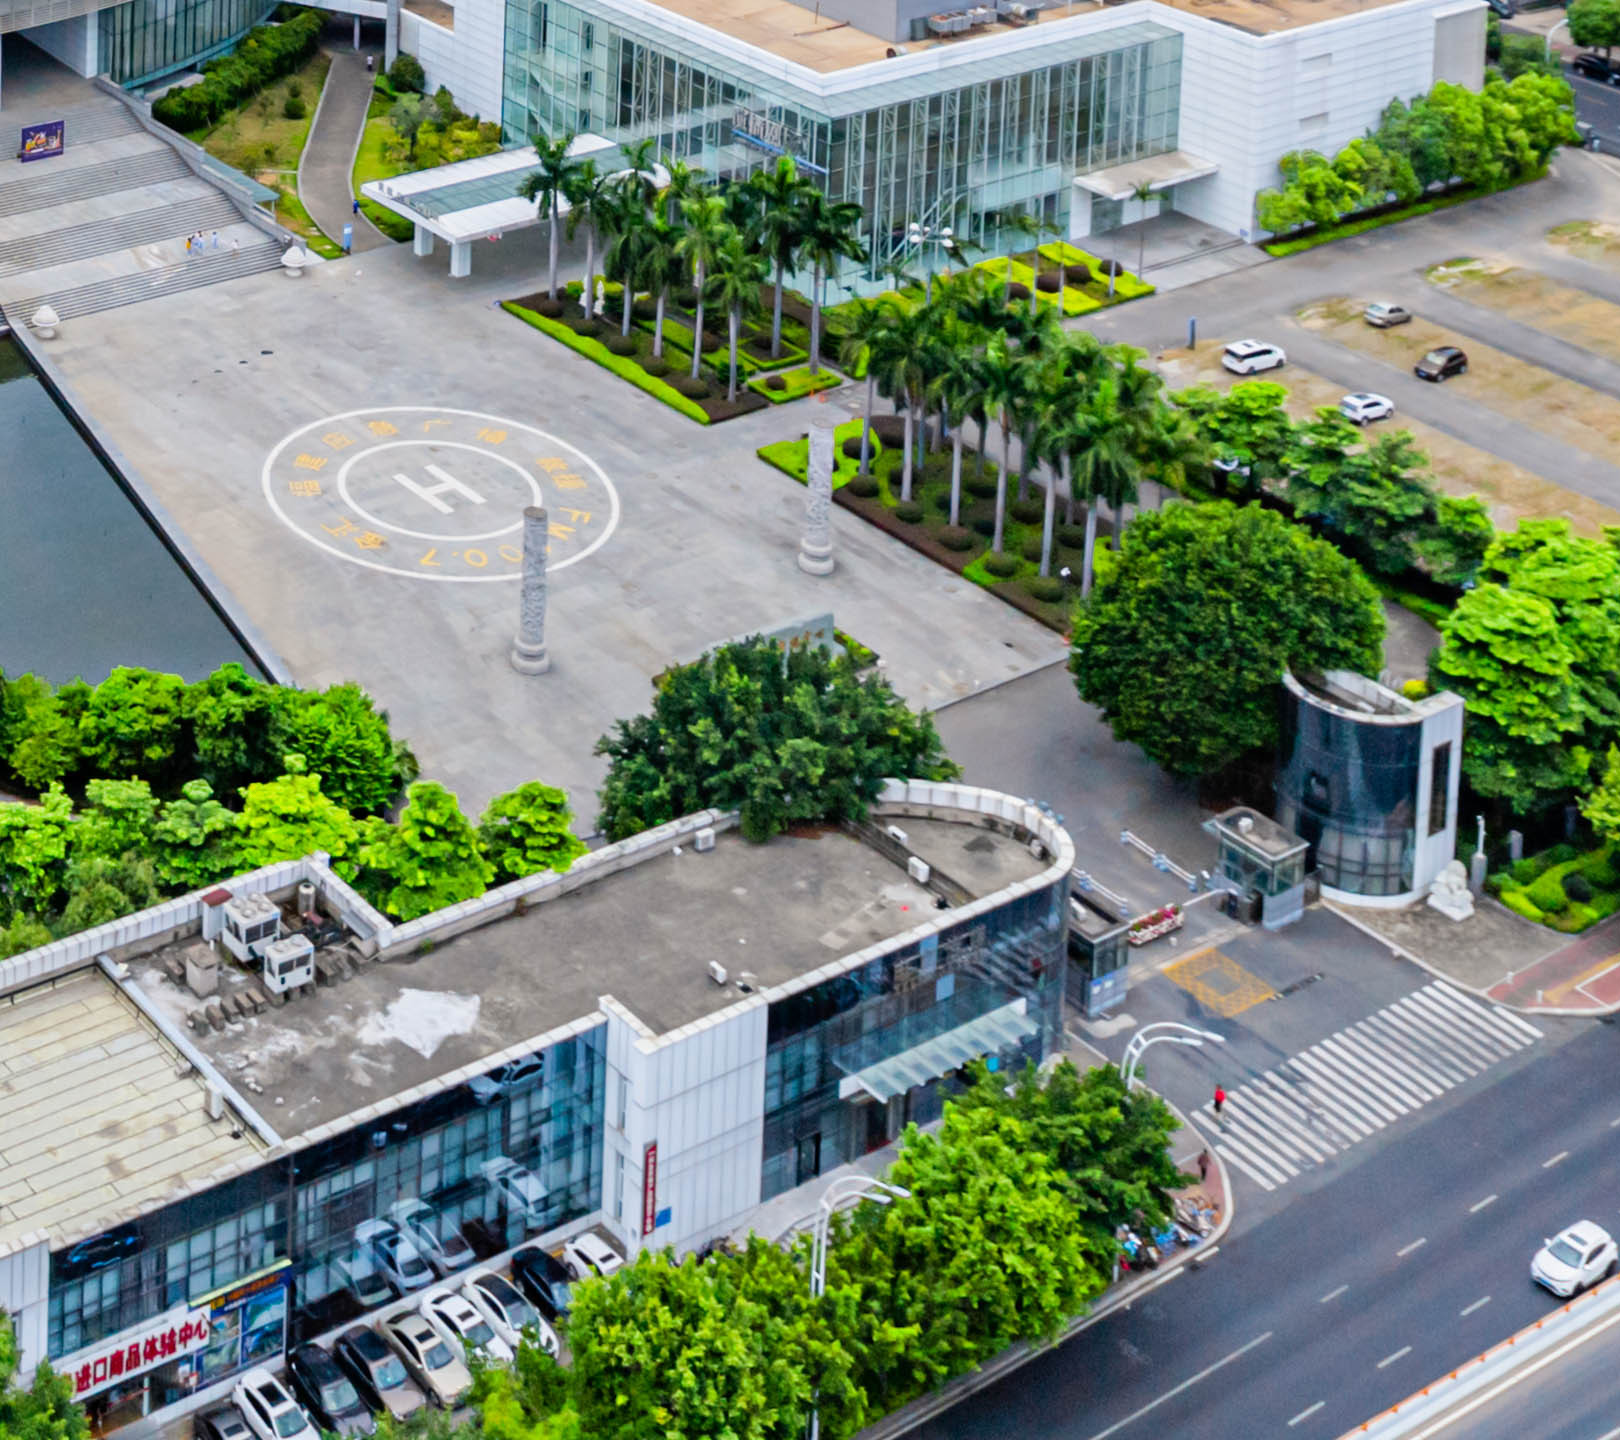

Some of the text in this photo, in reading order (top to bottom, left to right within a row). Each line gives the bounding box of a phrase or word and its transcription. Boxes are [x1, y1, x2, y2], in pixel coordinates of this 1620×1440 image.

[392, 463, 487, 515] H
[418, 506, 592, 569] FM00.7
[74, 1319, 208, 1394] 进口商品体验中心
